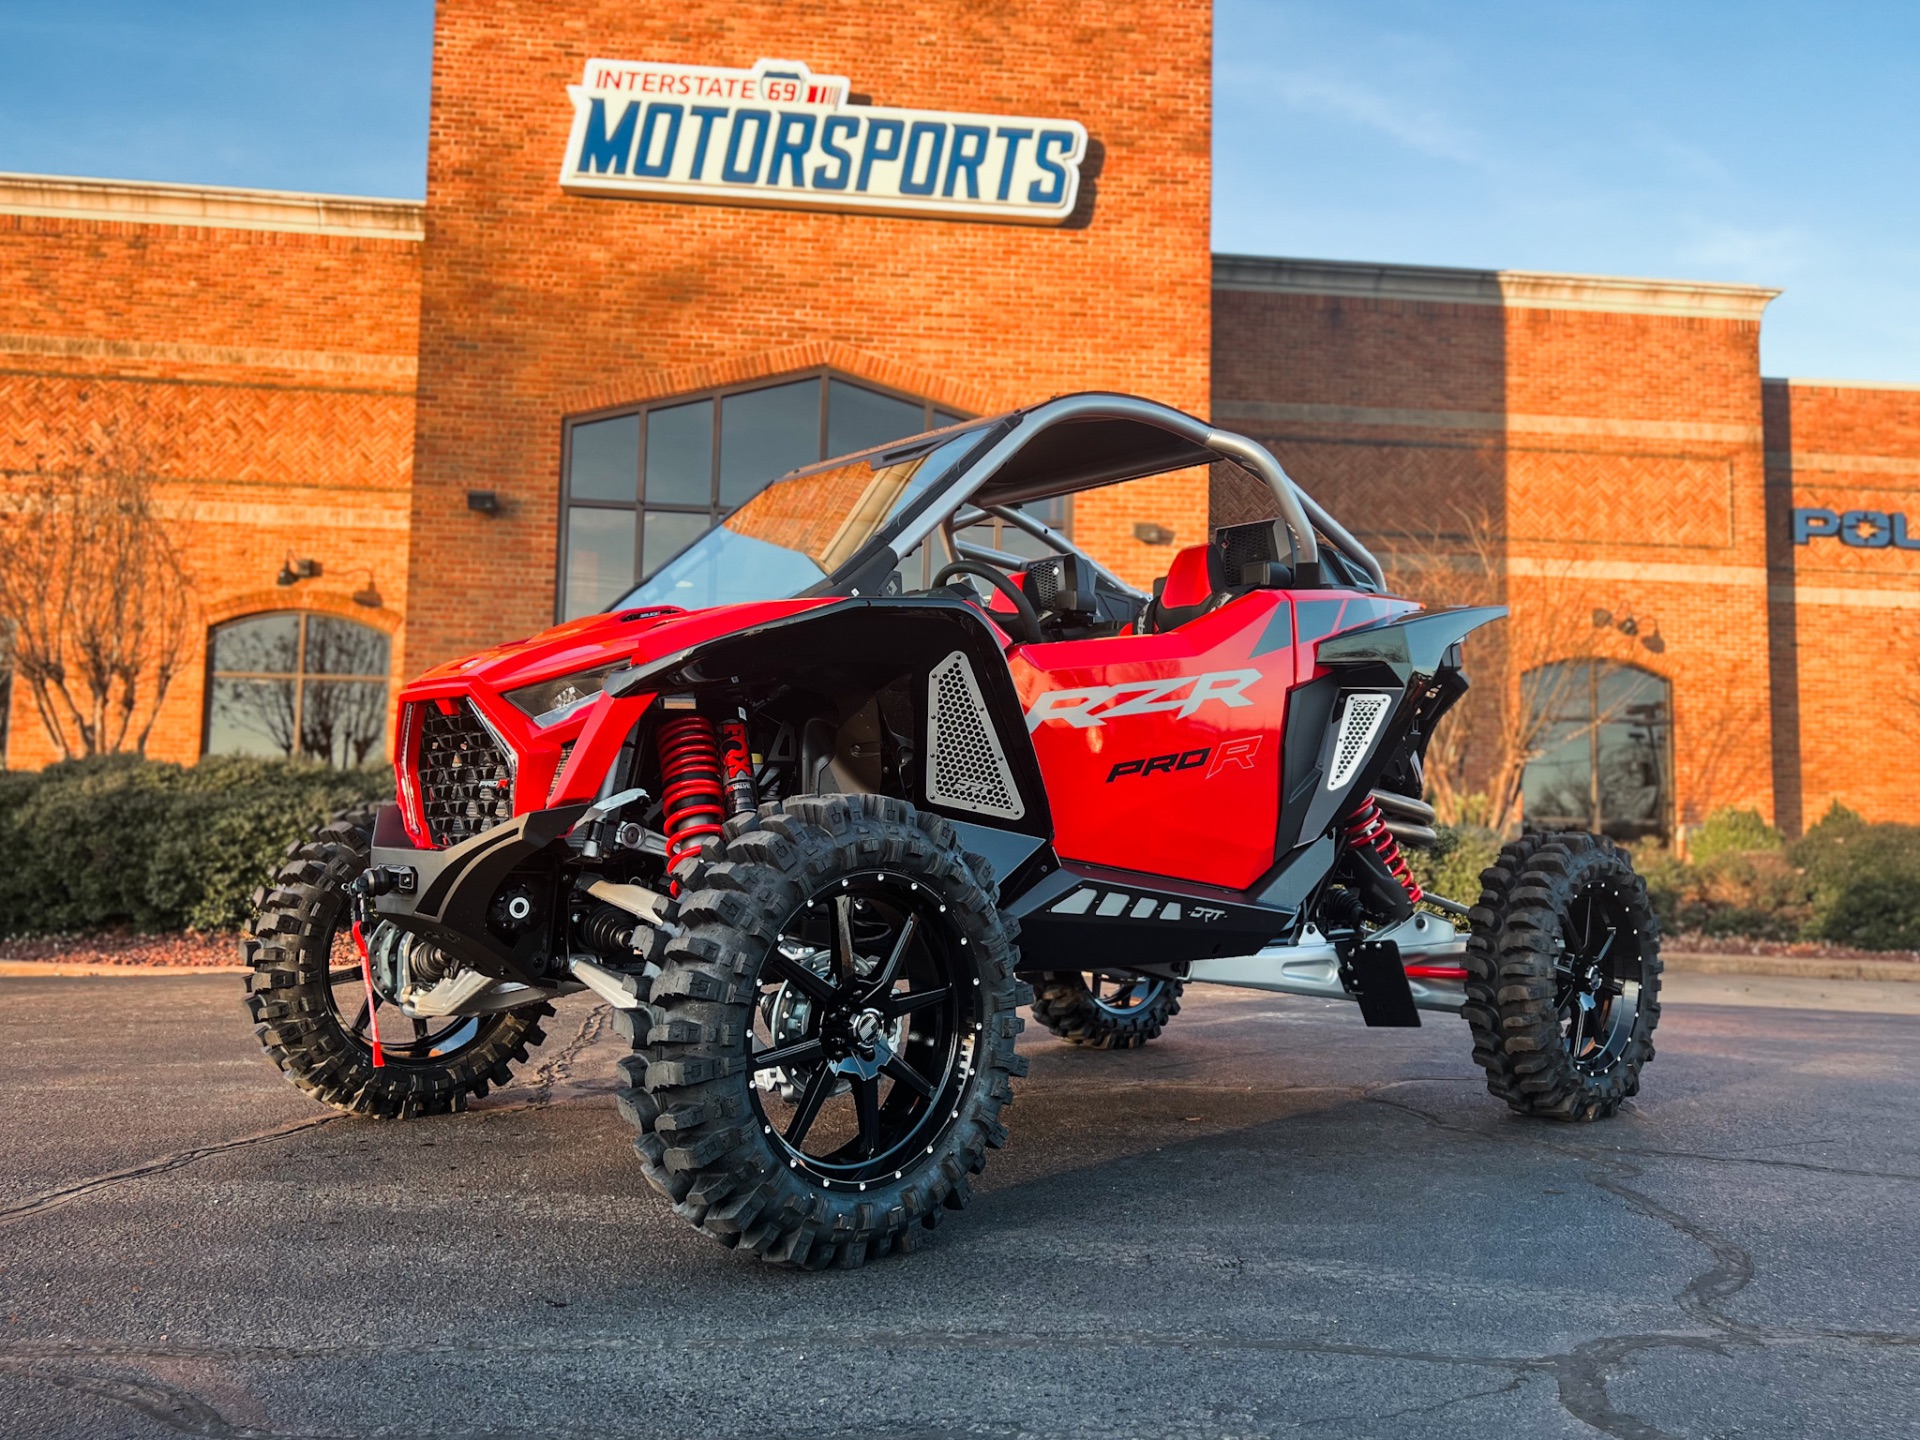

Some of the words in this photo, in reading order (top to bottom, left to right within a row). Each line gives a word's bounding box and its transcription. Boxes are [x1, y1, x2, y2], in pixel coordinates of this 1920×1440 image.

[596, 69, 757, 99] INTERSTATE
[768, 82, 797, 102] 69
[577, 97, 1075, 204] MOTORSPORTS
[1024, 668, 1264, 734] RZR
[722, 722, 752, 779] FOX
